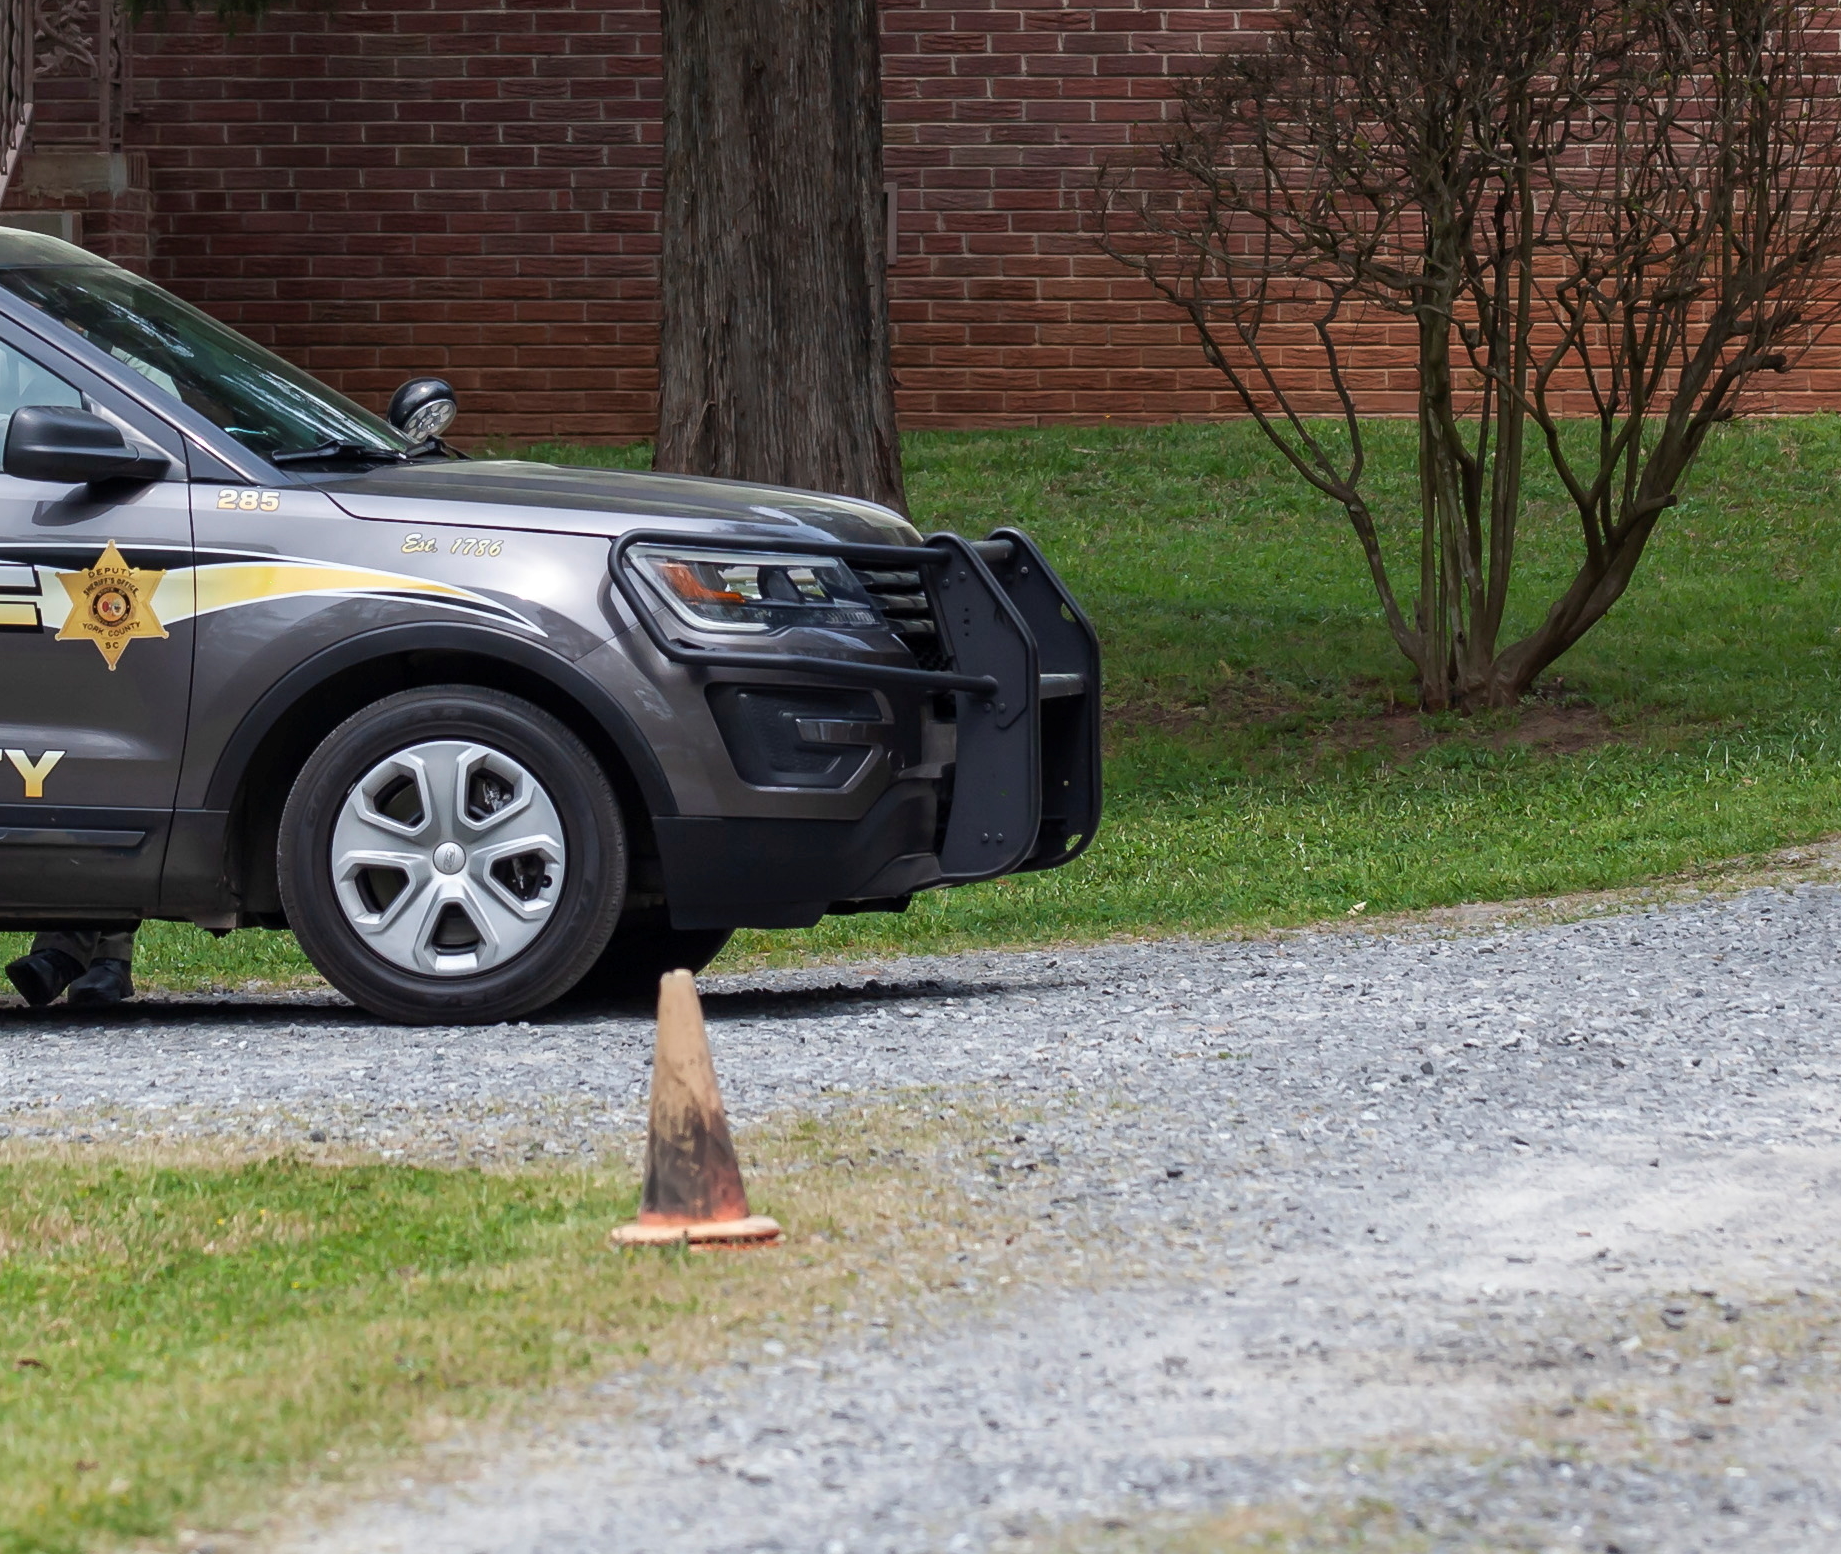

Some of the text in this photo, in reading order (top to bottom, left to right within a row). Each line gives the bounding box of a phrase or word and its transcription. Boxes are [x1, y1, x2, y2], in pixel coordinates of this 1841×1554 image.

[216, 489, 280, 511] 285
[401, 533, 504, 556] Est. 1786
[88, 567, 134, 578] DEPUTY
[83, 577, 139, 599] SHERIFF'S OFFICE
[82, 621, 140, 637] YORK COUNTY
[105, 641, 119, 649] SC
